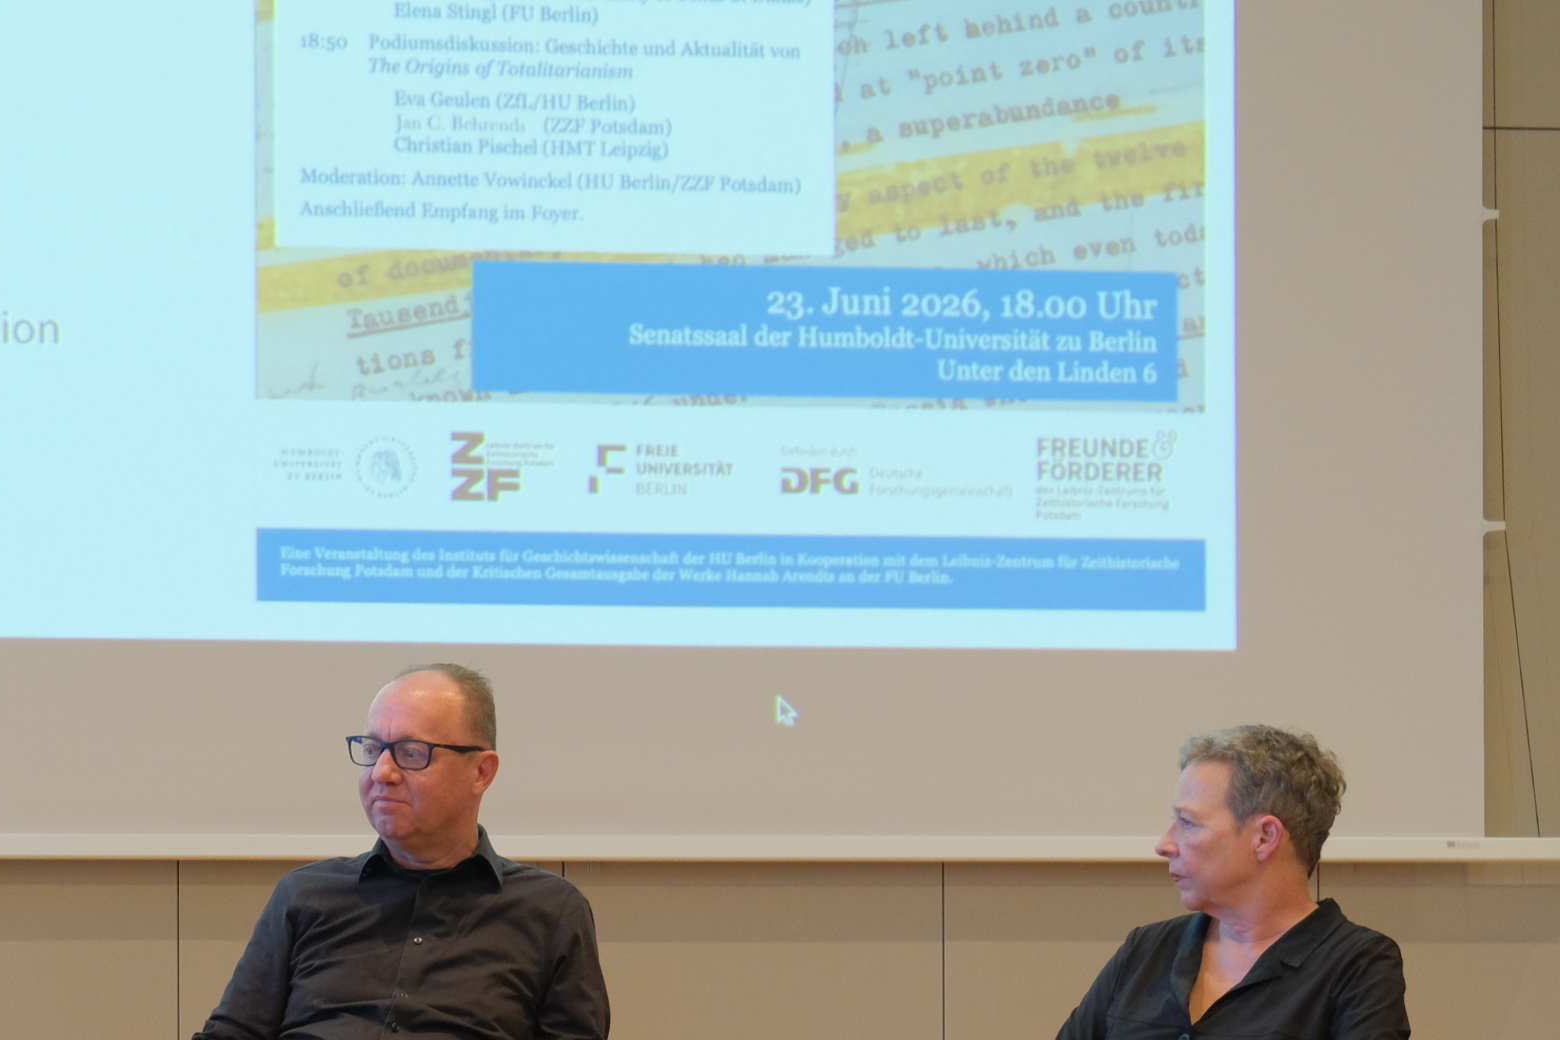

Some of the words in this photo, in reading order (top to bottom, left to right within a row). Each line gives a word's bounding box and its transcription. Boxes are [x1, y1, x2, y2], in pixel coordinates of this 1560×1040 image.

[395, 2, 442, 19] Elena
[447, 3, 496, 24] Stingl
[502, 5, 534, 22] (FU
[540, 6, 598, 25] Berlin)
[884, 23, 948, 50] left
[1076, 8, 1092, 24] a
[302, 33, 348, 52] 18:50
[369, 34, 539, 53] Podiumsdiskussion:
[545, 38, 638, 56] Geschichte
[643, 40, 675, 56] und
[681, 40, 764, 58] Aktualität
[770, 47, 800, 59] von
[369, 57, 400, 74] The
[405, 58, 470, 78] Origins
[475, 59, 495, 80] of
[494, 60, 633, 79] Totalitarianism
[860, 77, 890, 99] at
[906, 61, 1003, 95] "point
[1019, 46, 1096, 77] zero"
[1114, 40, 1145, 63] of
[395, 90, 425, 107] Eva
[430, 91, 490, 109] Geulen
[496, 92, 571, 111] (ZfL/HU
[577, 95, 635, 113] Berlin)
[396, 114, 421, 135] Jan
[427, 115, 441, 130] C.
[452, 115, 525, 133] Behrends
[543, 117, 585, 134] (ZZF
[591, 118, 672, 137] Potsdam)
[866, 127, 883, 145] a
[899, 90, 1122, 139] superabundance
[394, 136, 472, 154] Christian
[479, 138, 537, 155] Pischel
[543, 140, 595, 157] (HMT
[601, 141, 669, 161] Leipzig)
[301, 168, 405, 185] Moderation:
[412, 171, 479, 187] Annette
[484, 172, 572, 189] Vowinckel
[577, 173, 613, 191] (HU
[620, 174, 715, 193] Berlin/ZZF
[720, 176, 801, 195] Potsdam)
[867, 171, 964, 208] aspect
[980, 162, 1010, 187] of
[1030, 158, 1075, 181] the
[1093, 141, 1189, 171] twelve
[300, 200, 416, 218] Anschließend
[422, 202, 499, 224] Empfang
[504, 205, 525, 220] im
[532, 205, 583, 224] Foyer.
[893, 223, 920, 243] to
[940, 207, 1017, 234] last,
[1034, 199, 1081, 222] and
[1099, 191, 1144, 212] the
[1073, 237, 1136, 261] even
[337, 264, 370, 289] of
[768, 291, 814, 320] 23.
[822, 287, 891, 316] Juni
[902, 289, 990, 322] 2026,
[1002, 289, 1087, 319] 18.00
[1098, 290, 1157, 320] Uhr
[629, 323, 748, 347] Senatssaal
[754, 324, 792, 347] der
[799, 326, 1050, 351] Humboldt-Universität
[1056, 336, 1082, 352] zu
[1089, 330, 1157, 353] Berlin
[357, 349, 437, 378] tions
[938, 359, 1004, 382] Unter
[1009, 359, 1051, 382] den
[1058, 360, 1137, 383] Linden
[1143, 363, 1157, 384] 6
[636, 444, 677, 457] FREIE
[1037, 437, 1149, 459] FREUNDE
[636, 461, 732, 476] UNIVERSITÄT
[869, 467, 923, 479] Deutsche
[1037, 454, 1162, 482] FÖRDERER
[635, 482, 687, 496] BERLIN
[781, 468, 858, 495] DFG
[868, 483, 1012, 500] Forschungsgemeinschaft
[281, 546, 311, 559] Eine
[314, 546, 409, 563] Veranstaltung
[412, 548, 436, 561] des
[439, 549, 496, 562] Instituts
[499, 549, 519, 563] für
[523, 549, 679, 565] Geschichtswissenschaft
[682, 552, 705, 565] der
[709, 552, 732, 565] HU
[736, 552, 777, 566] Berlin
[780, 554, 794, 566] in
[797, 553, 880, 571] Kooperation
[883, 555, 905, 567] mit
[909, 554, 939, 567] dem
[942, 554, 1055, 568] Leibniz-Zentrum
[1058, 555, 1077, 569] für
[1081, 556, 1180, 570] Zeithistorische
[281, 563, 352, 580] Forschung
[355, 562, 414, 578] Potsdam
[416, 565, 444, 579] und
[446, 564, 469, 578] der
[473, 566, 542, 579] Kritischen
[545, 567, 650, 583] Gesamtausgabe
[652, 568, 675, 581] der
[679, 569, 722, 582] Werke
[726, 569, 779, 582] Hannah
[782, 569, 835, 583] Arendts
[838, 573, 855, 583] an
[858, 570, 881, 583] der
[885, 570, 904, 583] FU
[909, 570, 952, 584] Berlin.
